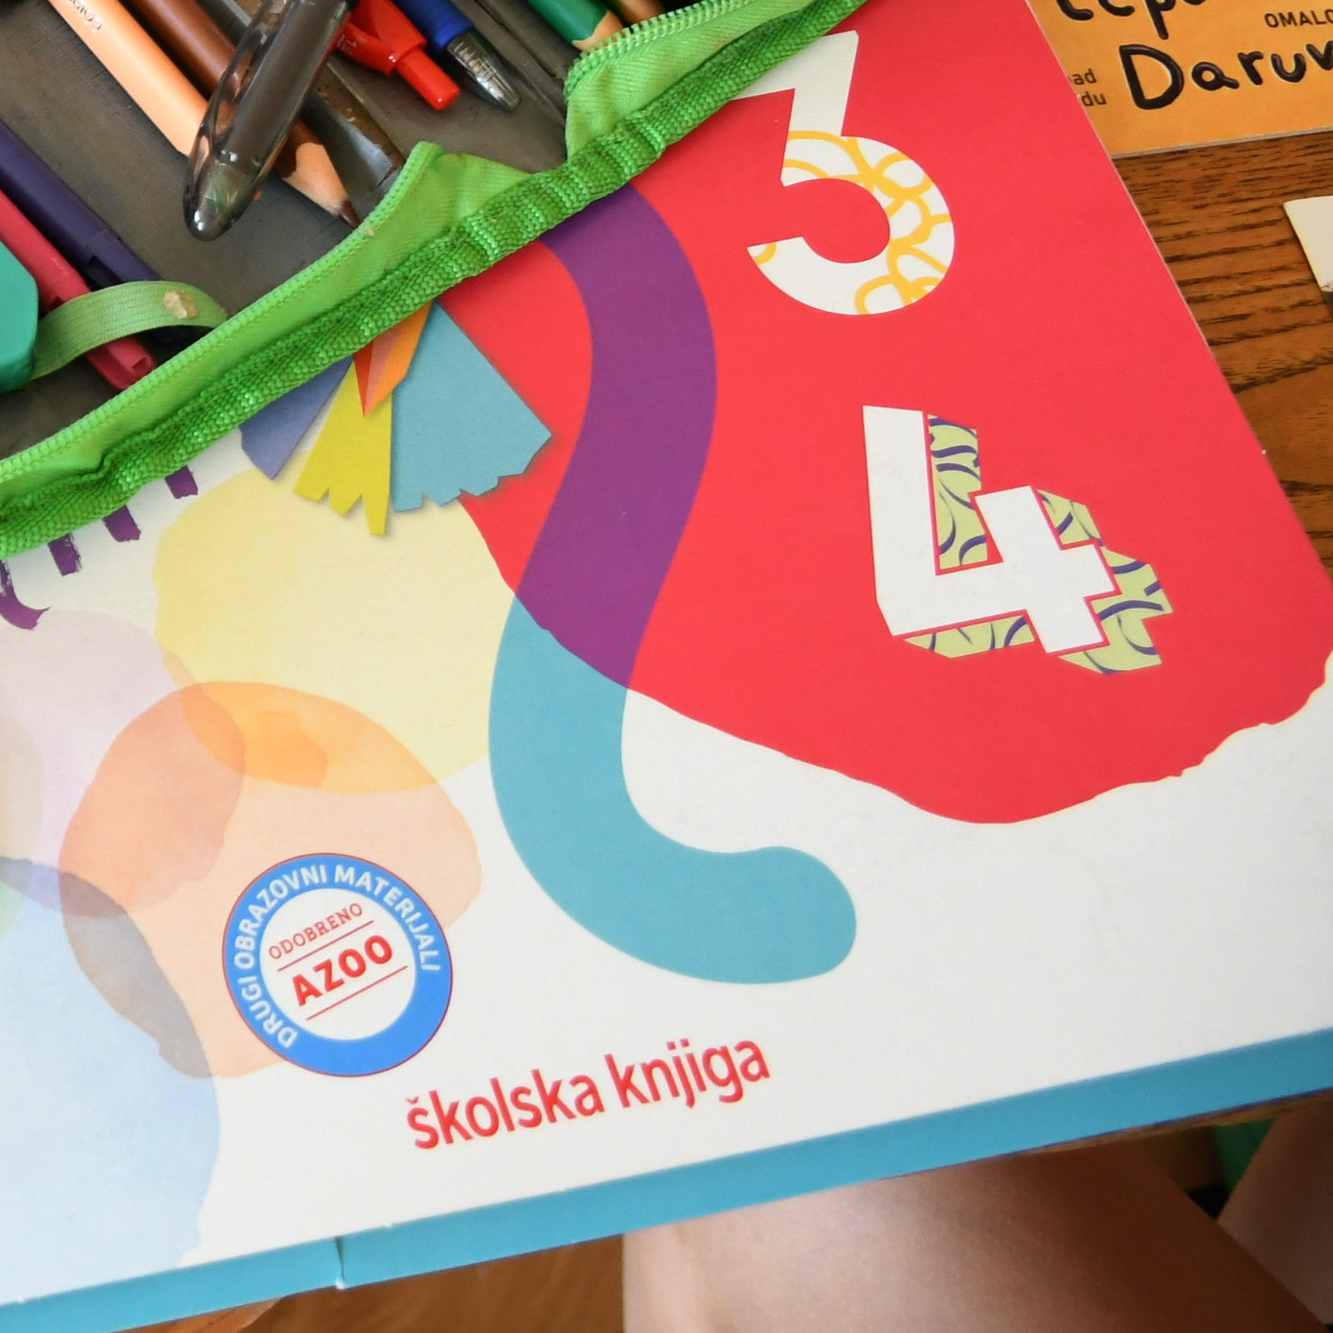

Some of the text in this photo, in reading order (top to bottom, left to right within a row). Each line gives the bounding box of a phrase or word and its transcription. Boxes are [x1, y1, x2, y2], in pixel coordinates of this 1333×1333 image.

[733, 28, 955, 315] 3
[863, 406, 1173, 673] 4
[234, 864, 440, 1048] DRUGI OBRAZOVNI MATERIJALI
[268, 902, 363, 959] ODOBRENO
[292, 935, 393, 1006] AZOO
[406, 1038, 771, 1150] školska knjiga
